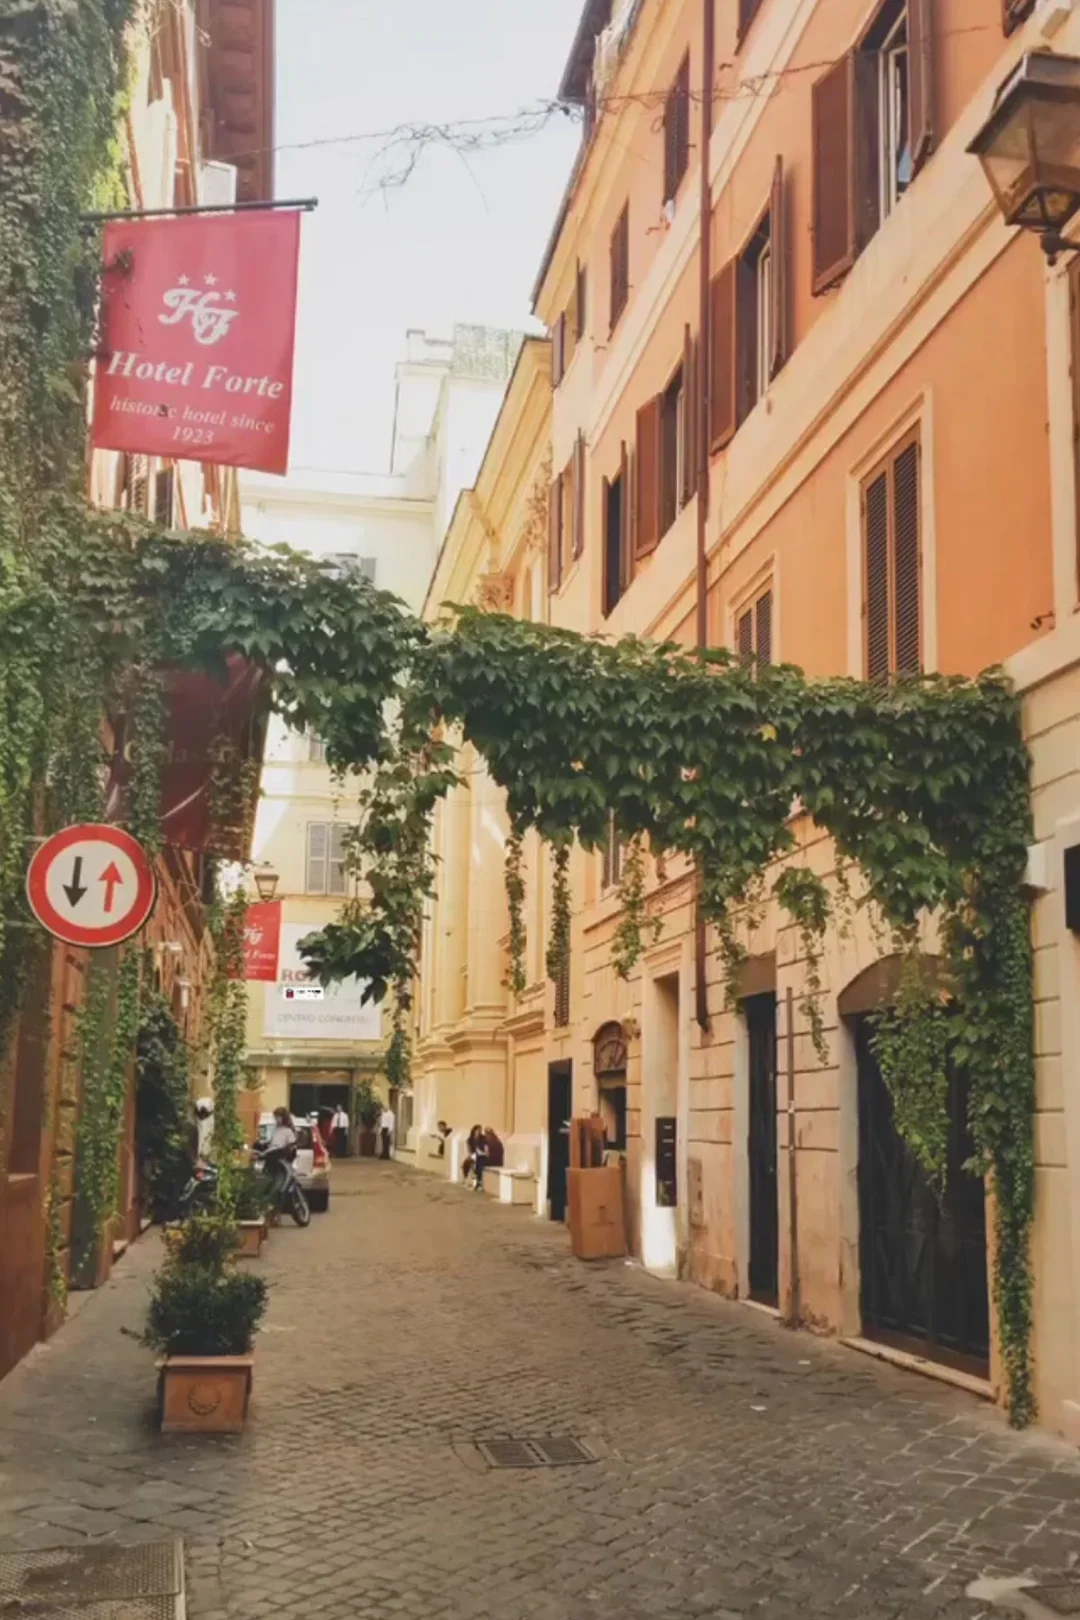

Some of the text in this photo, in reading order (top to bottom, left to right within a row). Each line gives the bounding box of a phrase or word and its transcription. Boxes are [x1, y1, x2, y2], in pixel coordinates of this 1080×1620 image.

[107, 352, 284, 398] Hotel Forte
[110, 393, 275, 434] historc hotel since
[172, 425, 214, 445] 1923
